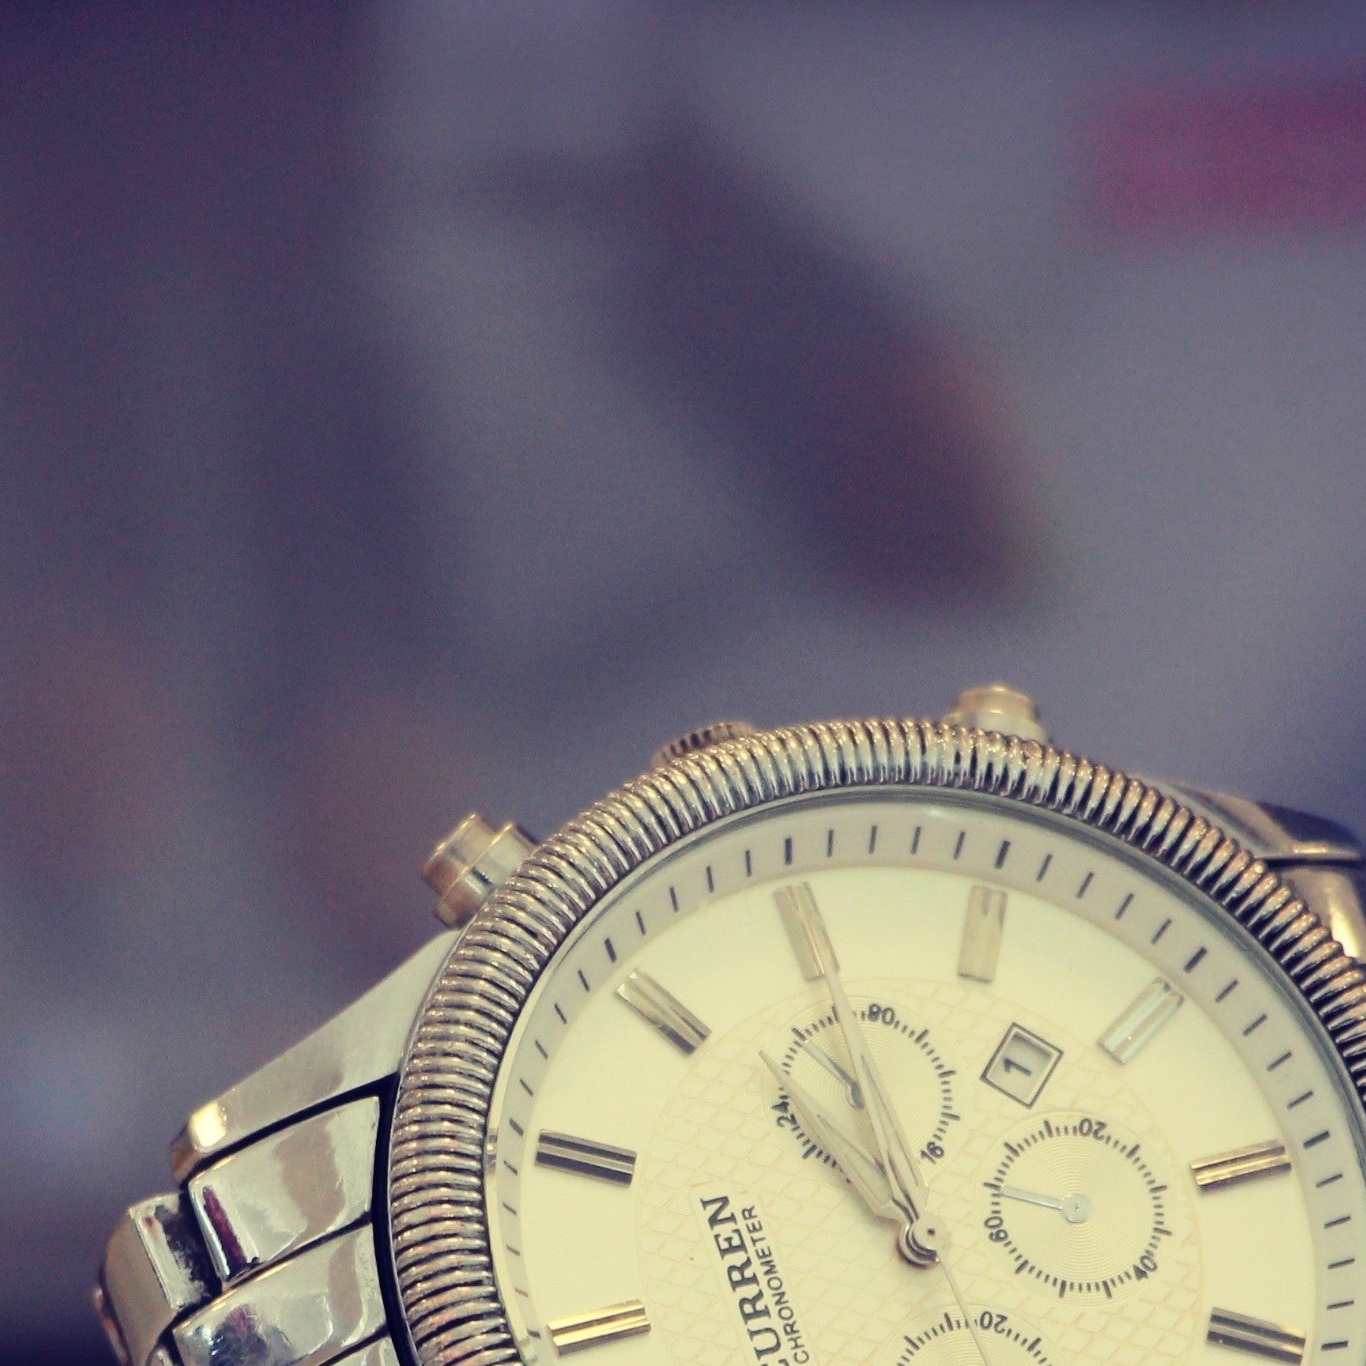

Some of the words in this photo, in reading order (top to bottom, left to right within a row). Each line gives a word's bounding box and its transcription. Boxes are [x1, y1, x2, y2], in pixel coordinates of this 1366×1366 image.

[1002, 1056, 1032, 1076] 1
[1079, 1118, 1107, 1141] 20
[984, 1215, 1009, 1243] 60
[1132, 1254, 1158, 1281] 40
[741, 1205, 810, 1364] CHRONOMETER
[979, 1311, 1008, 1334] 20
